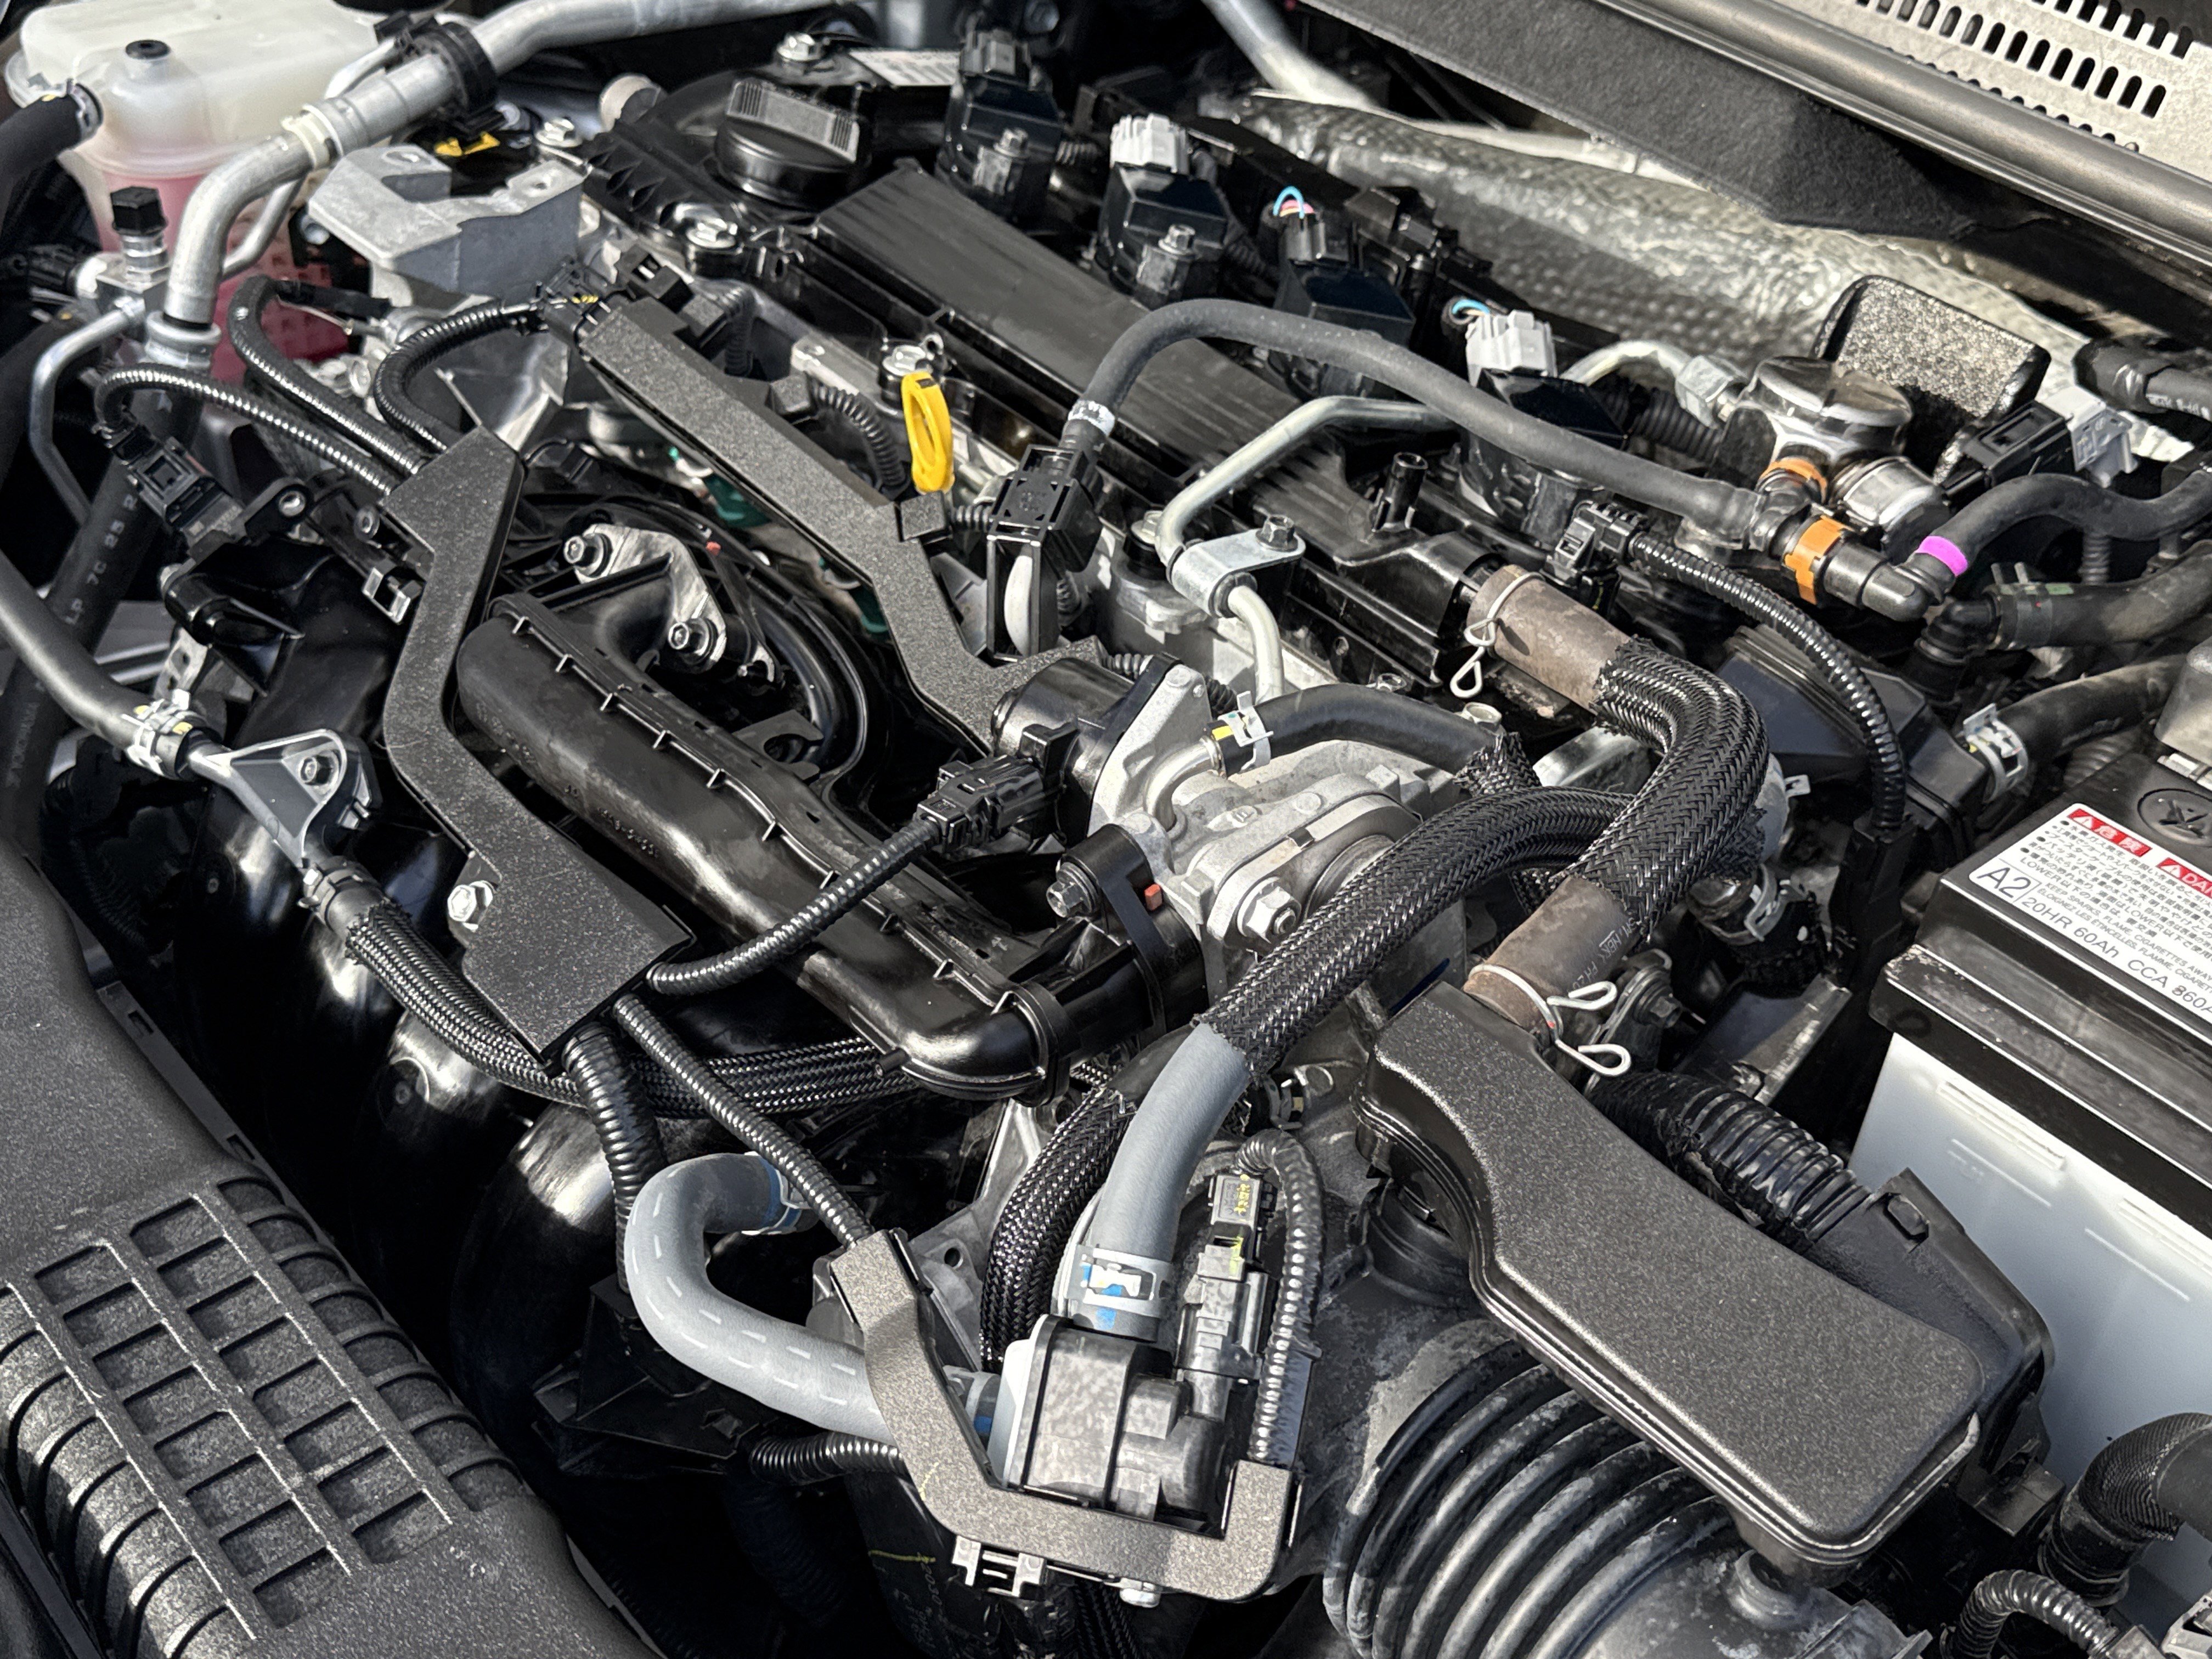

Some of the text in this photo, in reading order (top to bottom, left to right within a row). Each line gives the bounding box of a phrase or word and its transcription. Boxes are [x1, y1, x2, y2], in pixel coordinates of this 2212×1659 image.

[2093, 825, 2143, 853] 危険
[1976, 867, 2032, 899] A2
[2021, 897, 2073, 929] 20HR
[2073, 927, 2119, 958] 60Ah
[2128, 960, 2168, 988] CCA
